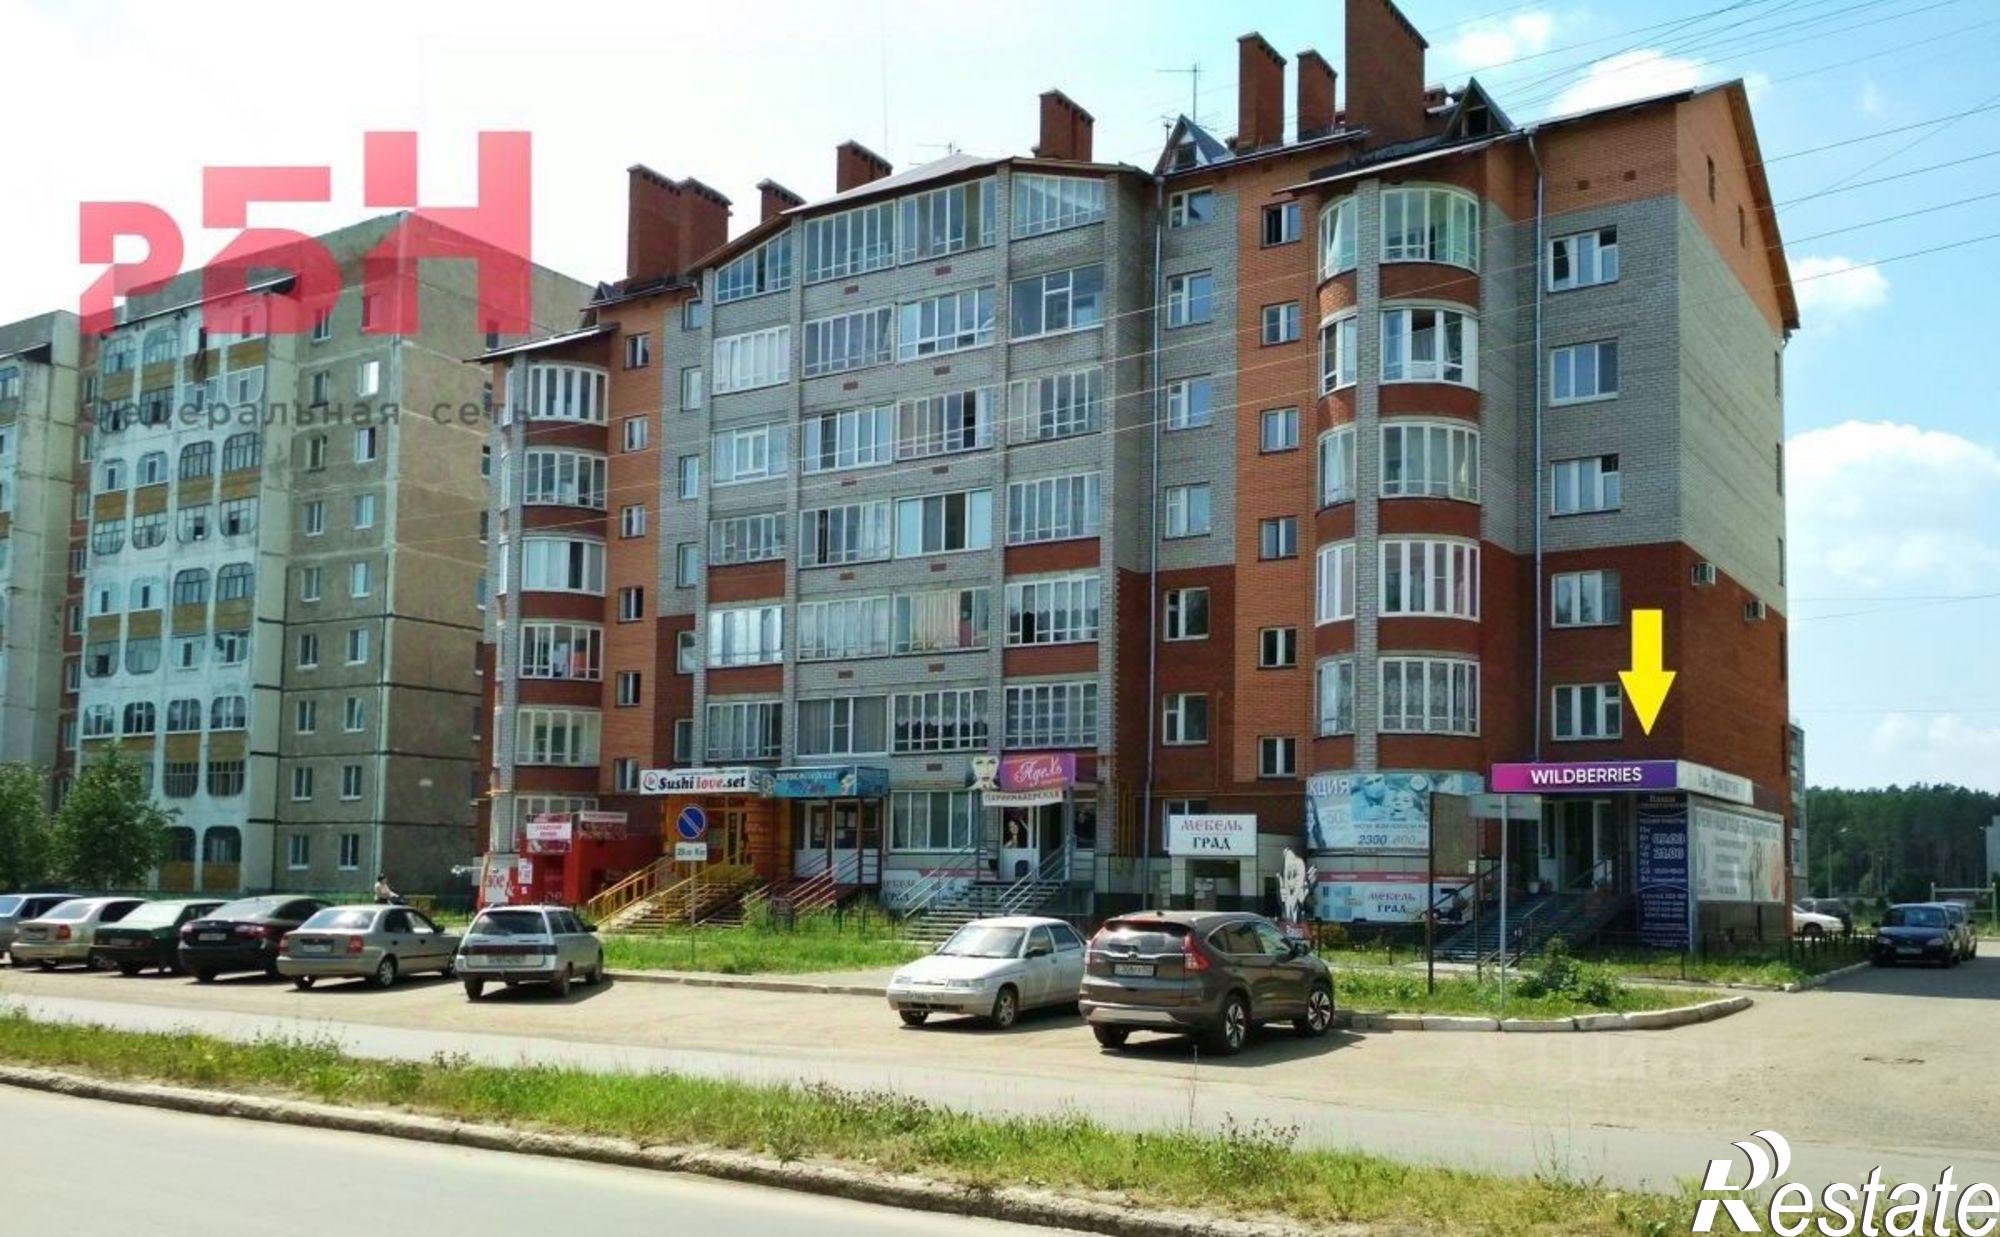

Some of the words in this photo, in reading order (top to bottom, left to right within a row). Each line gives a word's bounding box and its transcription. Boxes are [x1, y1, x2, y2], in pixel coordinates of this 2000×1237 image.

[1531, 767, 1643, 785] WILDBERRIES
[1193, 836, 1232, 851] ГРАД
[1358, 834, 1388, 846] 2300
